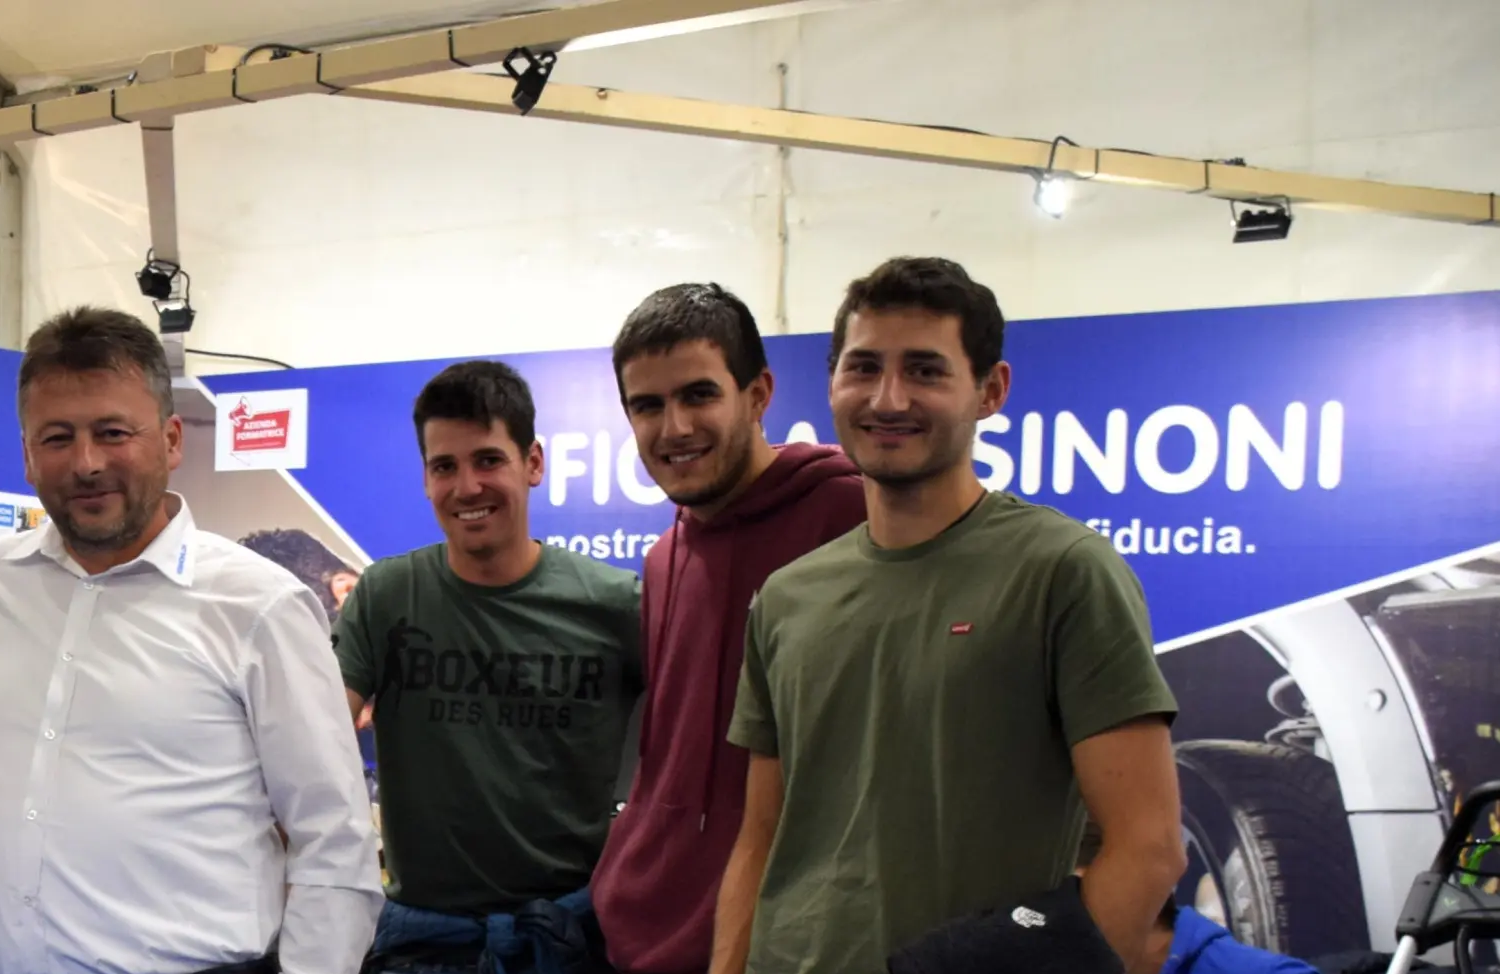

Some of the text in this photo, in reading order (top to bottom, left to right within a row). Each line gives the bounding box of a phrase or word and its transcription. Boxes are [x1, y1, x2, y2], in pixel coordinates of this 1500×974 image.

[971, 400, 1345, 496] SINONI
[399, 649, 604, 699] BOXEUR
[428, 698, 572, 730] DES RUES
